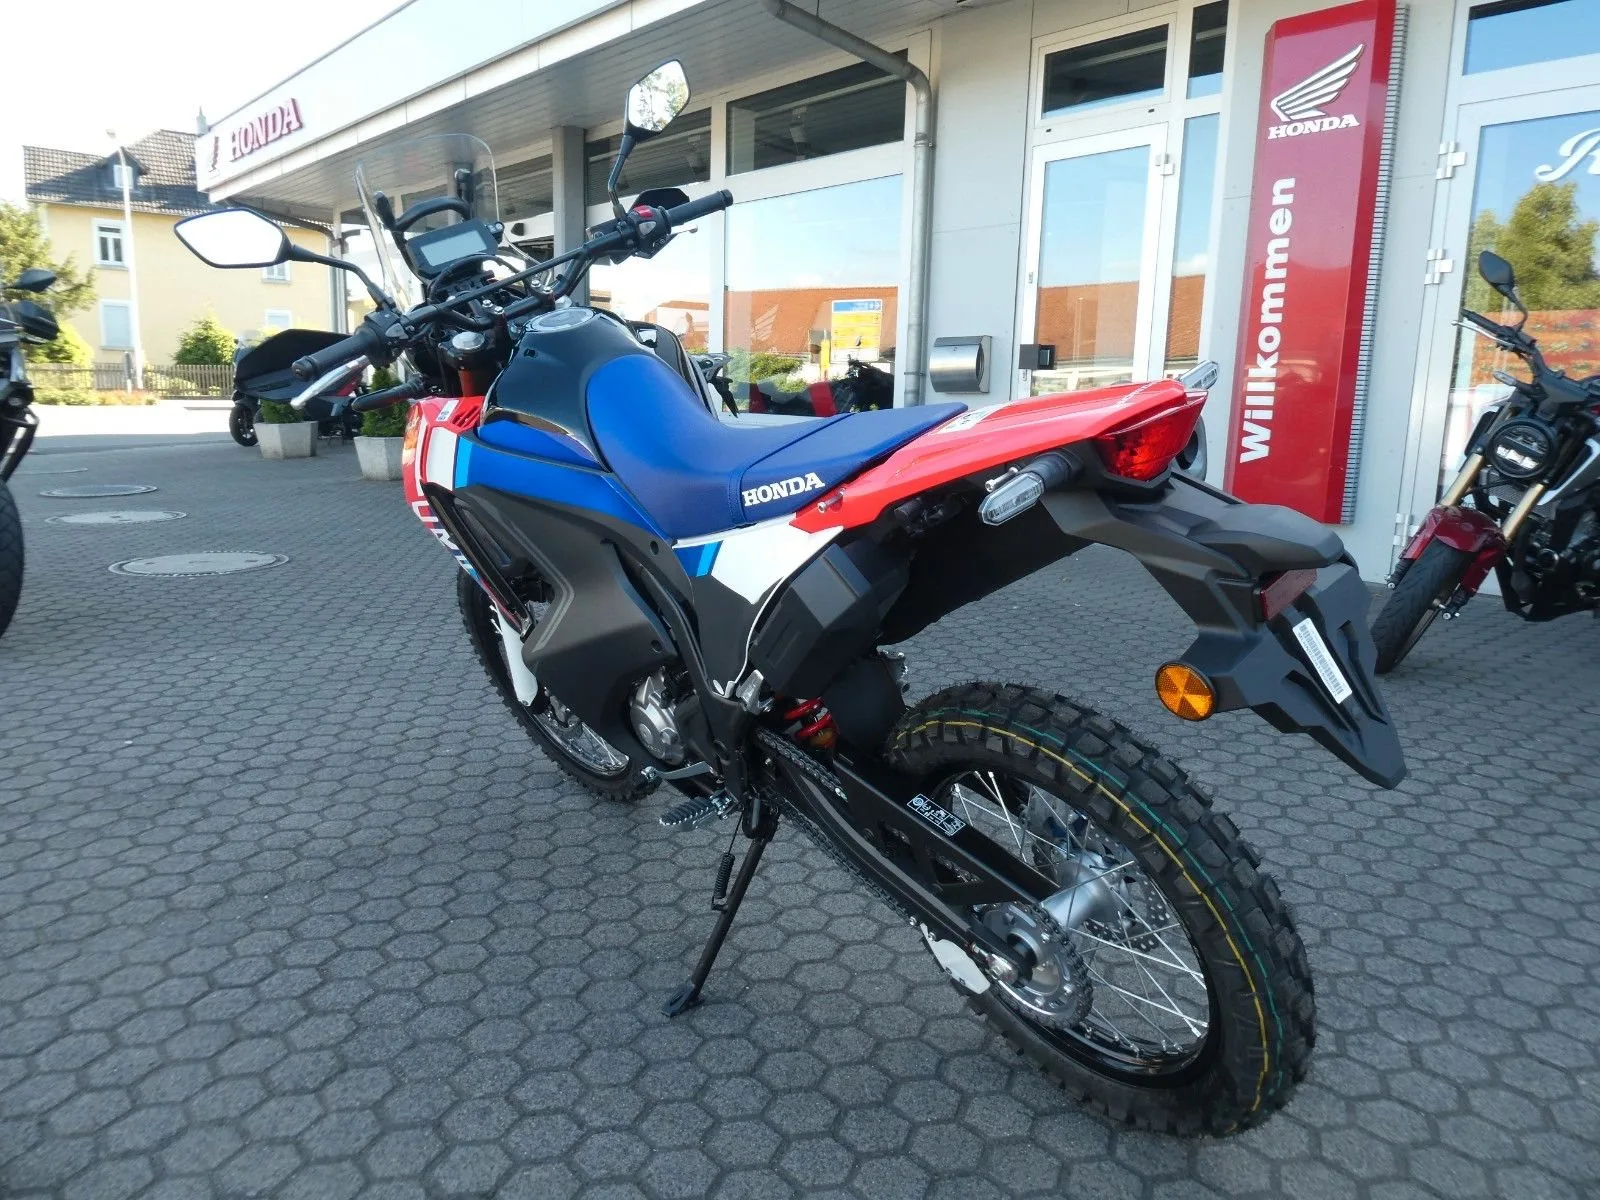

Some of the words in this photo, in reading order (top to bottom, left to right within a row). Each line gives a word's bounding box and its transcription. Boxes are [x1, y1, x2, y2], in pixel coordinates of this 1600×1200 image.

[229, 97, 303, 162] HONDA
[1267, 114, 1360, 139] HONDA
[1240, 177, 1296, 463] Willkommen
[742, 472, 826, 506] HONDA
